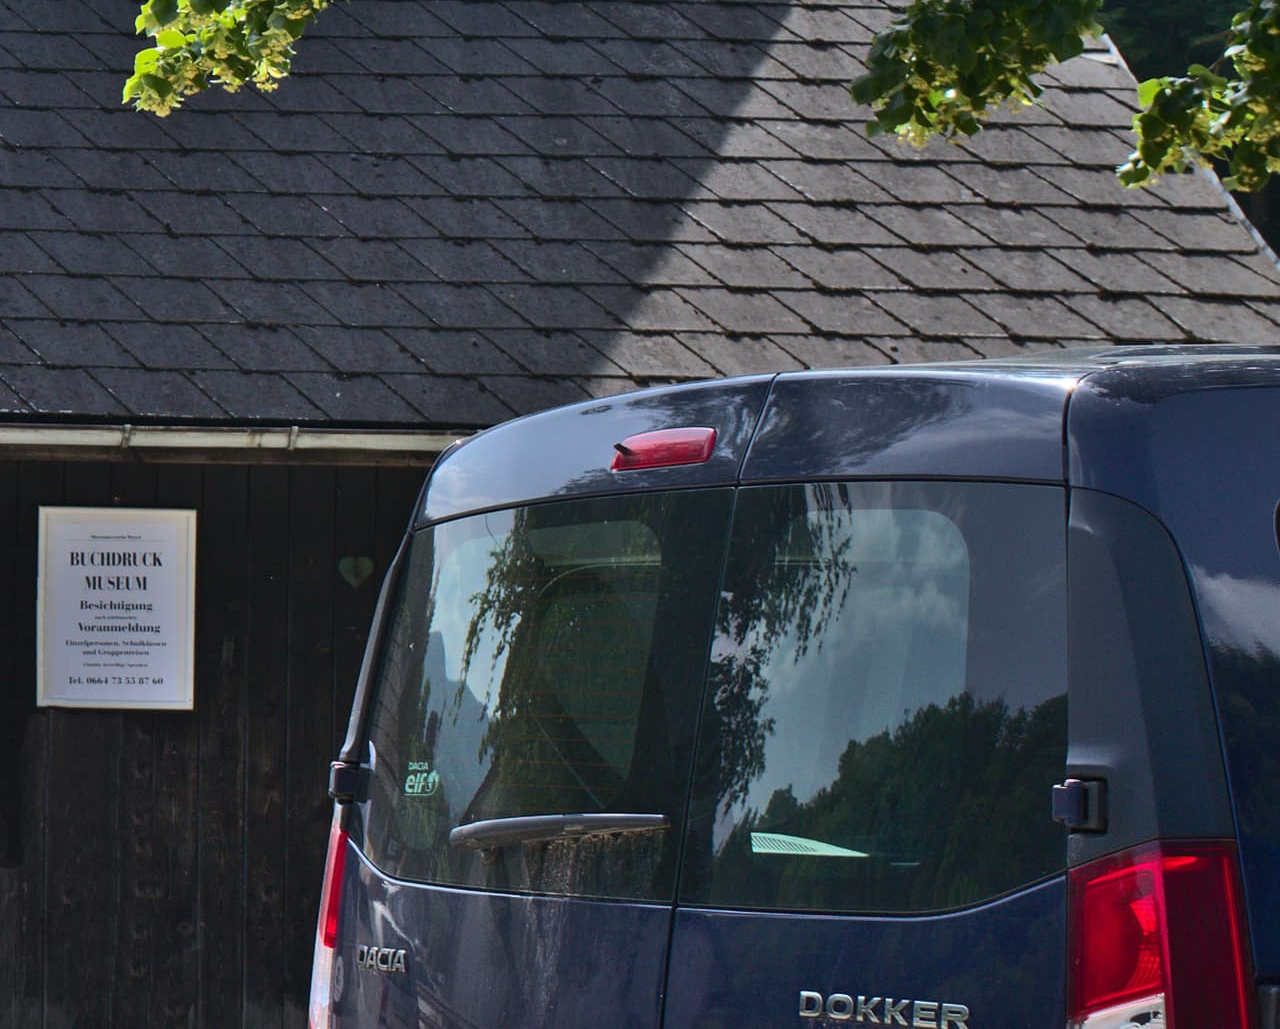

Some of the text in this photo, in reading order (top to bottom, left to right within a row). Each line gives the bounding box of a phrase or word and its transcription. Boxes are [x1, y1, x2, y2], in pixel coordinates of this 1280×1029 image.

[70, 552, 163, 567] BUCHDRUCK
[85, 576, 148, 591] MUSEUM
[79, 600, 153, 612] Besichtigung
[78, 622, 161, 634] Voranmeldung
[407, 761, 429, 771] DACIA
[404, 772, 427, 793] elf
[356, 944, 408, 973] DACIA
[798, 990, 971, 1029] DOKKER
